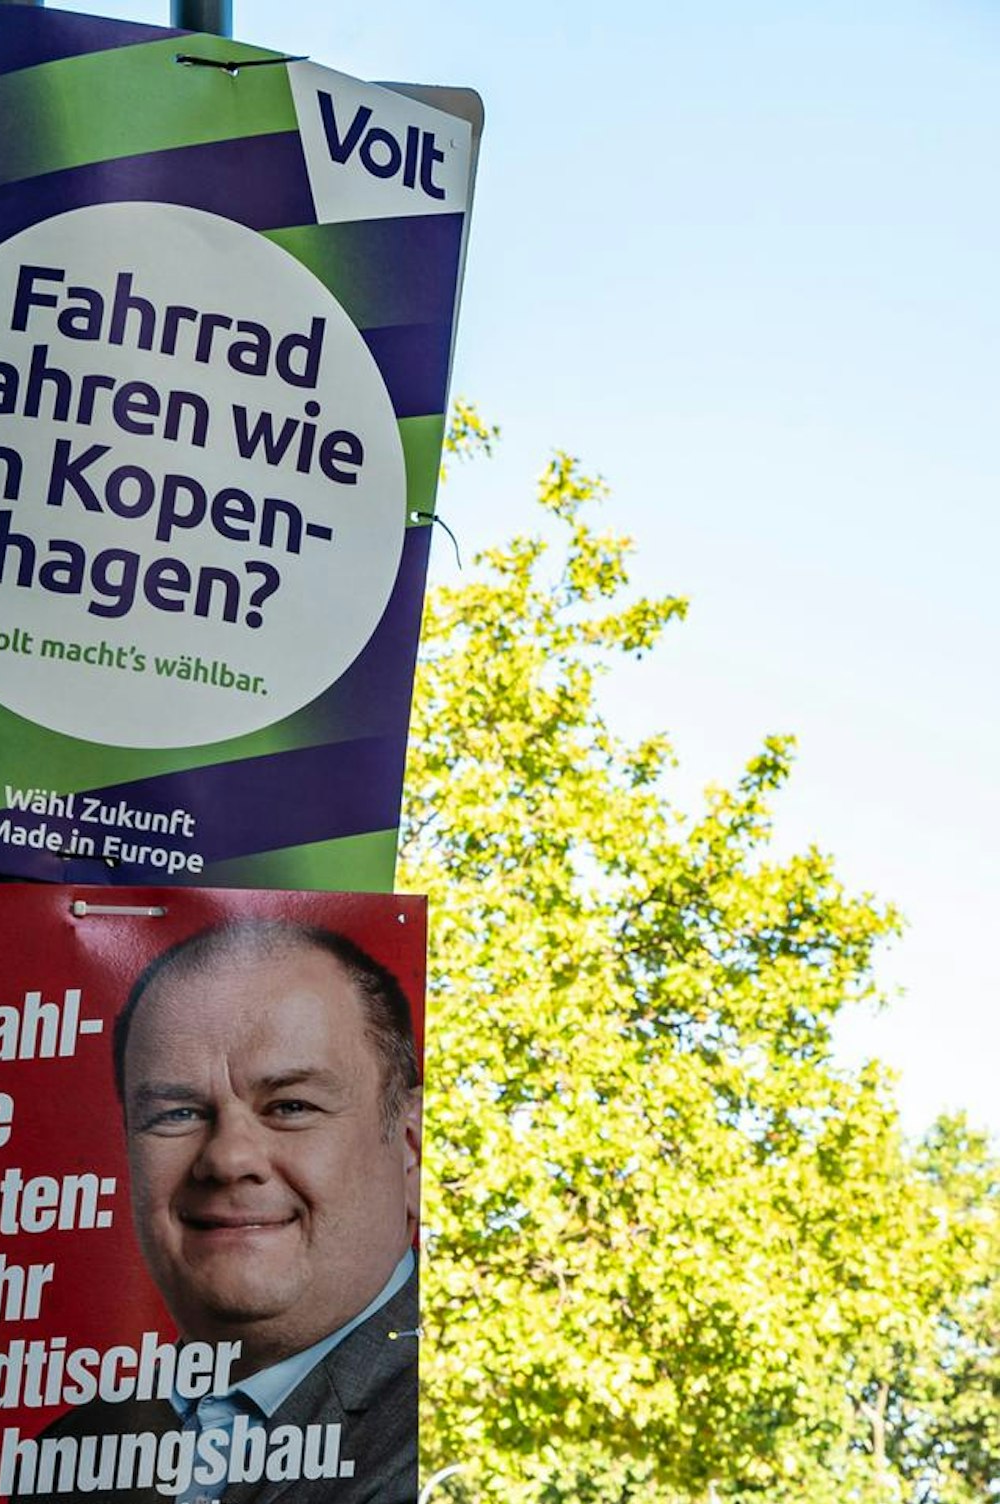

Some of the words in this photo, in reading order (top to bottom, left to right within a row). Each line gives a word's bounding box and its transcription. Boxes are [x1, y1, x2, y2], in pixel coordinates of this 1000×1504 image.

[316, 89, 445, 200] Volt
[10, 264, 327, 389] Fahrrad
[232, 400, 364, 485] wie
[46, 438, 334, 554] Kopen-
[154, 655, 268, 695] wählbar.
[4, 785, 75, 819] Wähl
[80, 797, 196, 838] Zukunft
[69, 829, 95, 857] in
[103, 836, 204, 875] Europe
